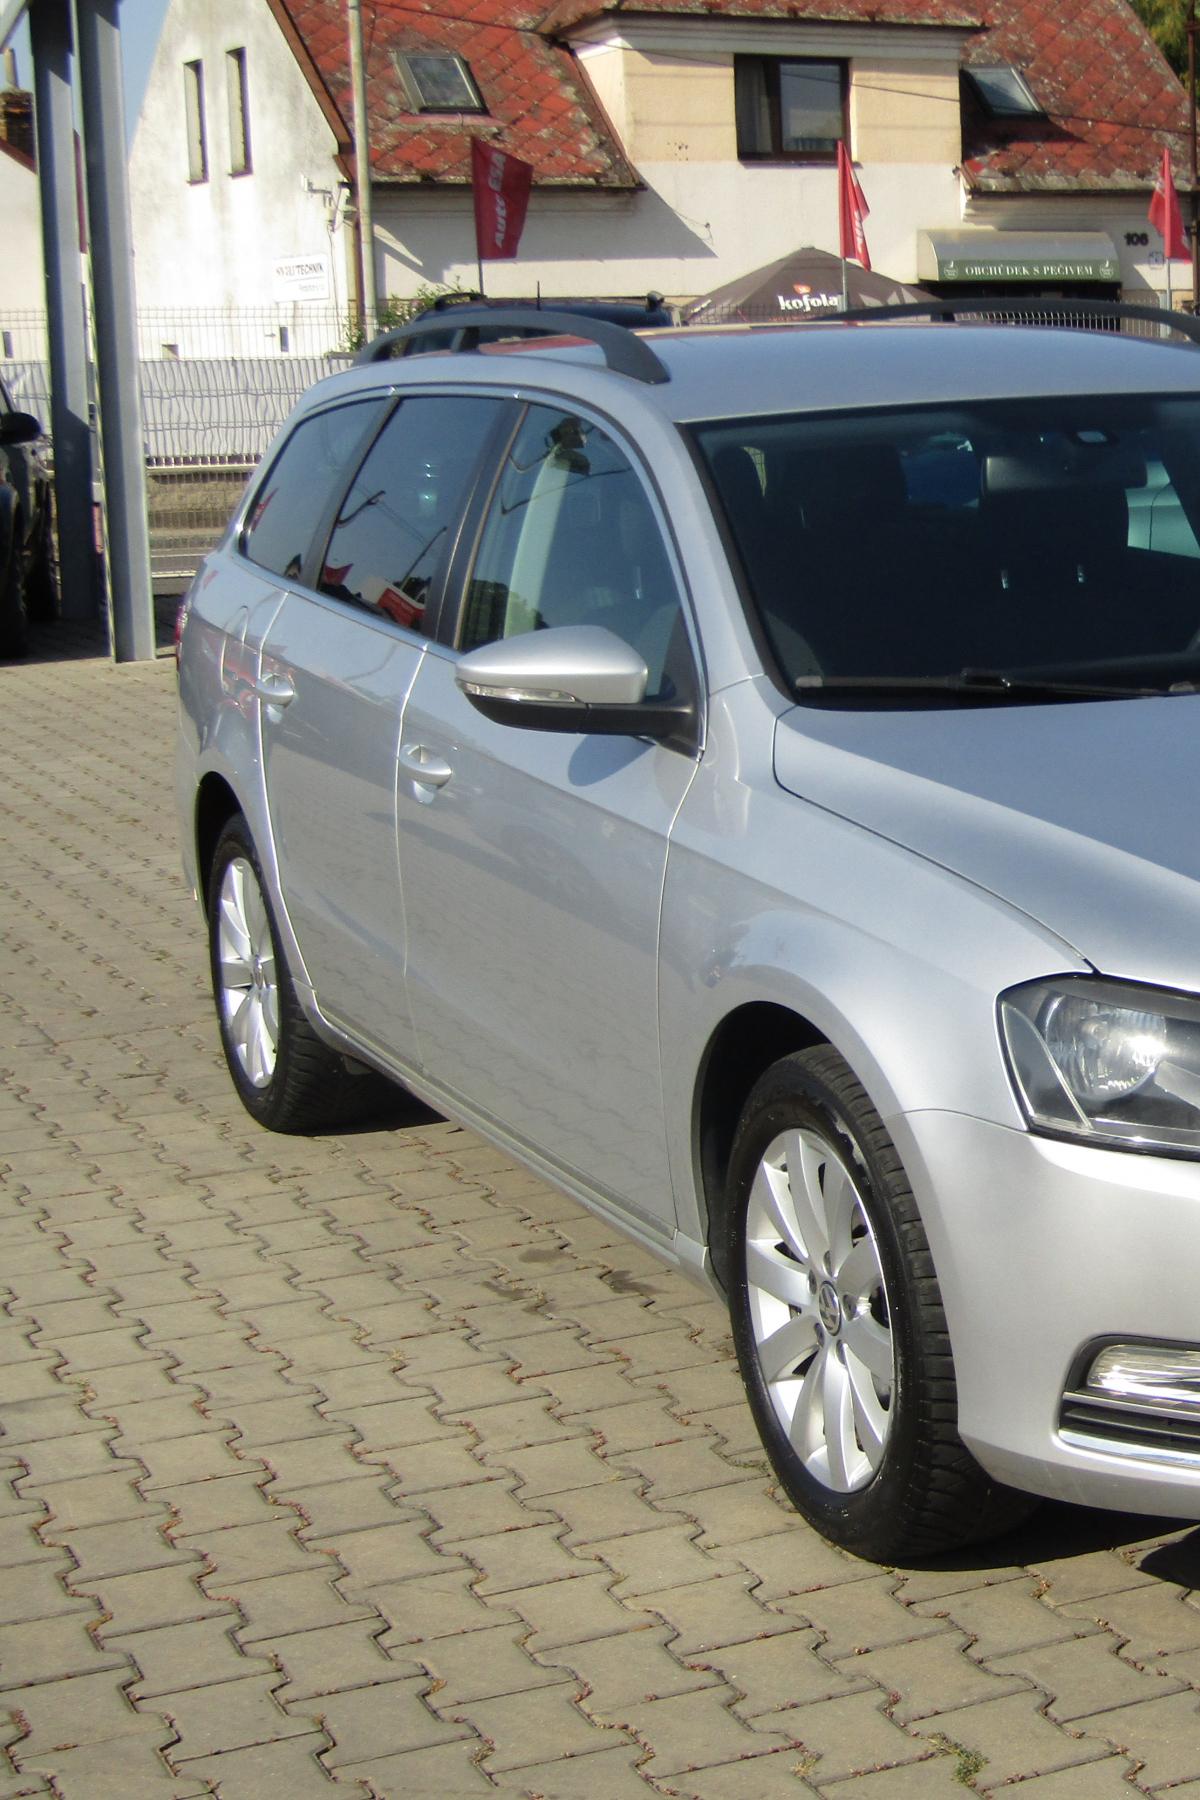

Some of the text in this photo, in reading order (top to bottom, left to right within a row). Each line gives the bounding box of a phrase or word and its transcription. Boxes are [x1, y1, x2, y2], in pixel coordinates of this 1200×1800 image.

[488, 152, 506, 249] Auto ESA
[1033, 265, 1041, 276] S
[777, 293, 839, 313] kofola
